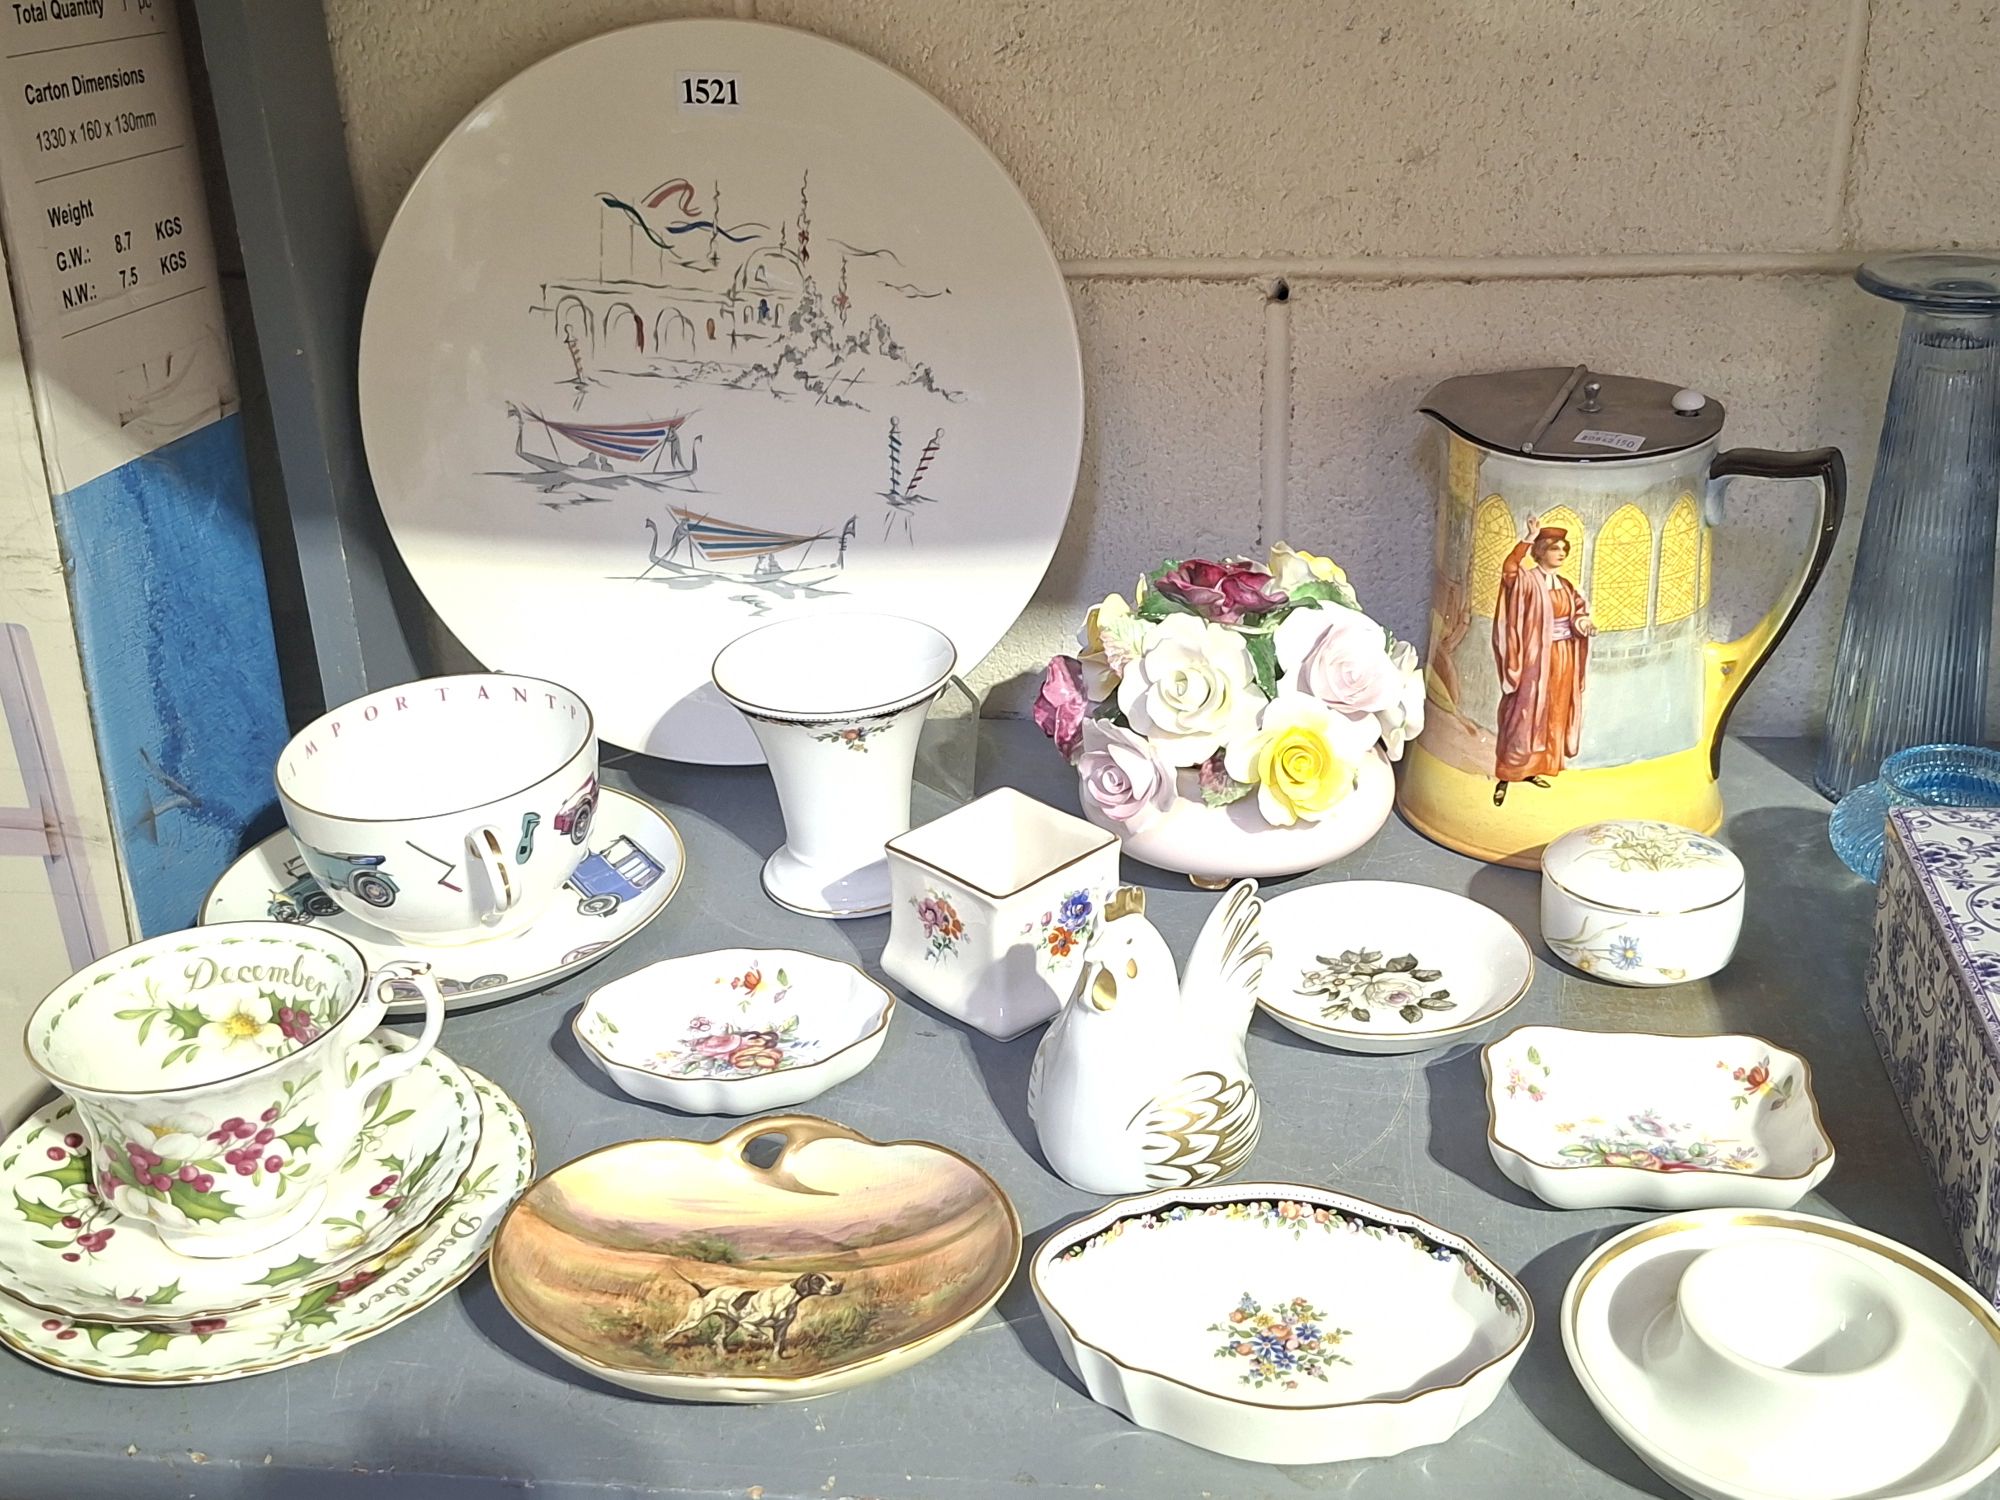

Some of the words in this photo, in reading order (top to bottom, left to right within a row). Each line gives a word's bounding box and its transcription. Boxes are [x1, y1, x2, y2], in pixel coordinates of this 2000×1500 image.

[13, 1, 48, 25] Total
[50, 0, 104, 19] Quantity
[24, 81, 70, 105] Carton
[72, 67, 146, 96] Dimensions
[682, 78, 740, 105] 1521
[36, 127, 67, 152] 1330
[70, 131, 78, 145] x
[80, 119, 102, 141] 160
[105, 122, 114, 137] x
[114, 111, 157, 134] 130mm
[48, 199, 94, 228] Weight
[56, 246, 92, 272] G.W.:
[114, 231, 132, 254] 8.7
[155, 216, 183, 240] KGS
[62, 282, 97, 309] N.W.:
[119, 267, 138, 289] 7.5
[160, 251, 187, 275] KGS
[183, 954, 328, 997] December
[352, 1212, 482, 1315] December
